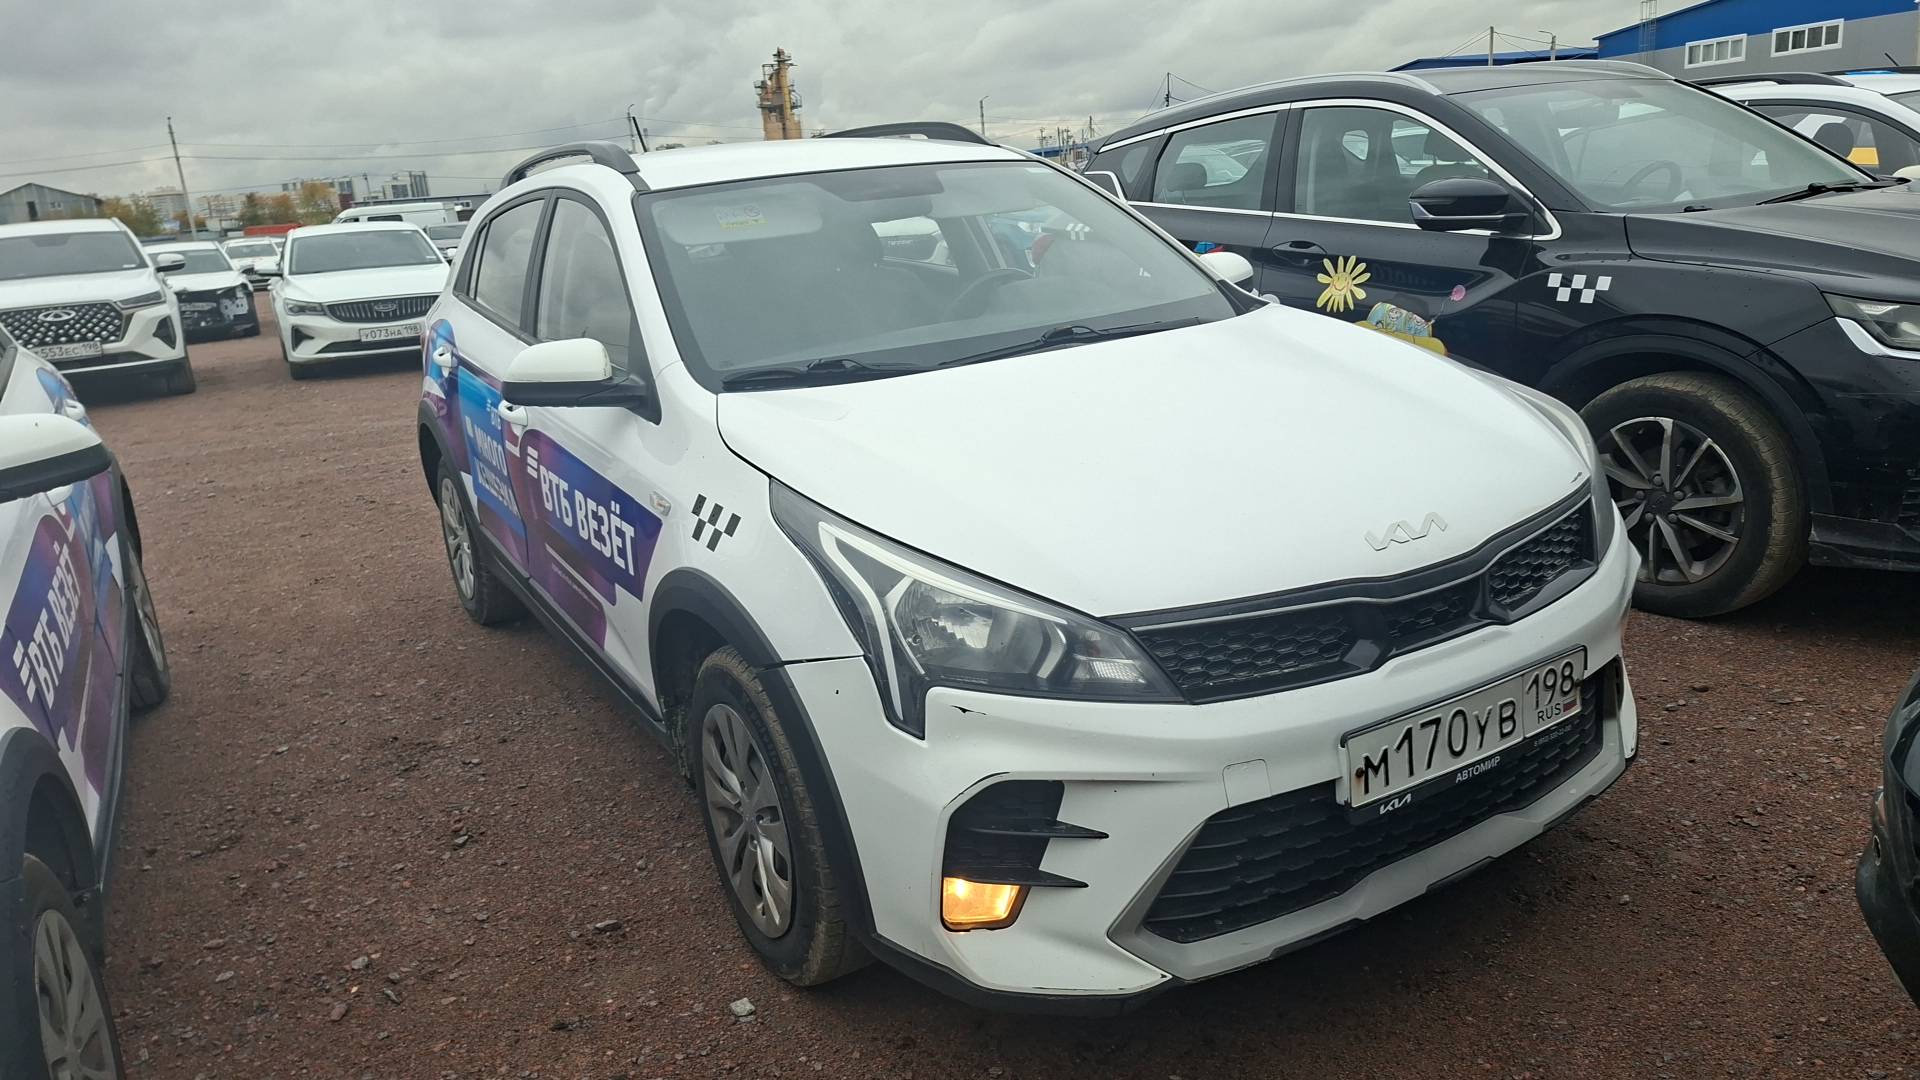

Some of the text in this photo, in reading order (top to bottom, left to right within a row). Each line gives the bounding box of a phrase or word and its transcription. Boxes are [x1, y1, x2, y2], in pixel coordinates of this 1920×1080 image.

[539, 464, 636, 576] ВТБ ВЕЗЁТ
[28, 541, 81, 709] ВТБ ВЕЗЁТ
[1526, 660, 1576, 711] 198
[1536, 702, 1562, 725] RUS
[1455, 755, 1501, 783] АВТОМИР
